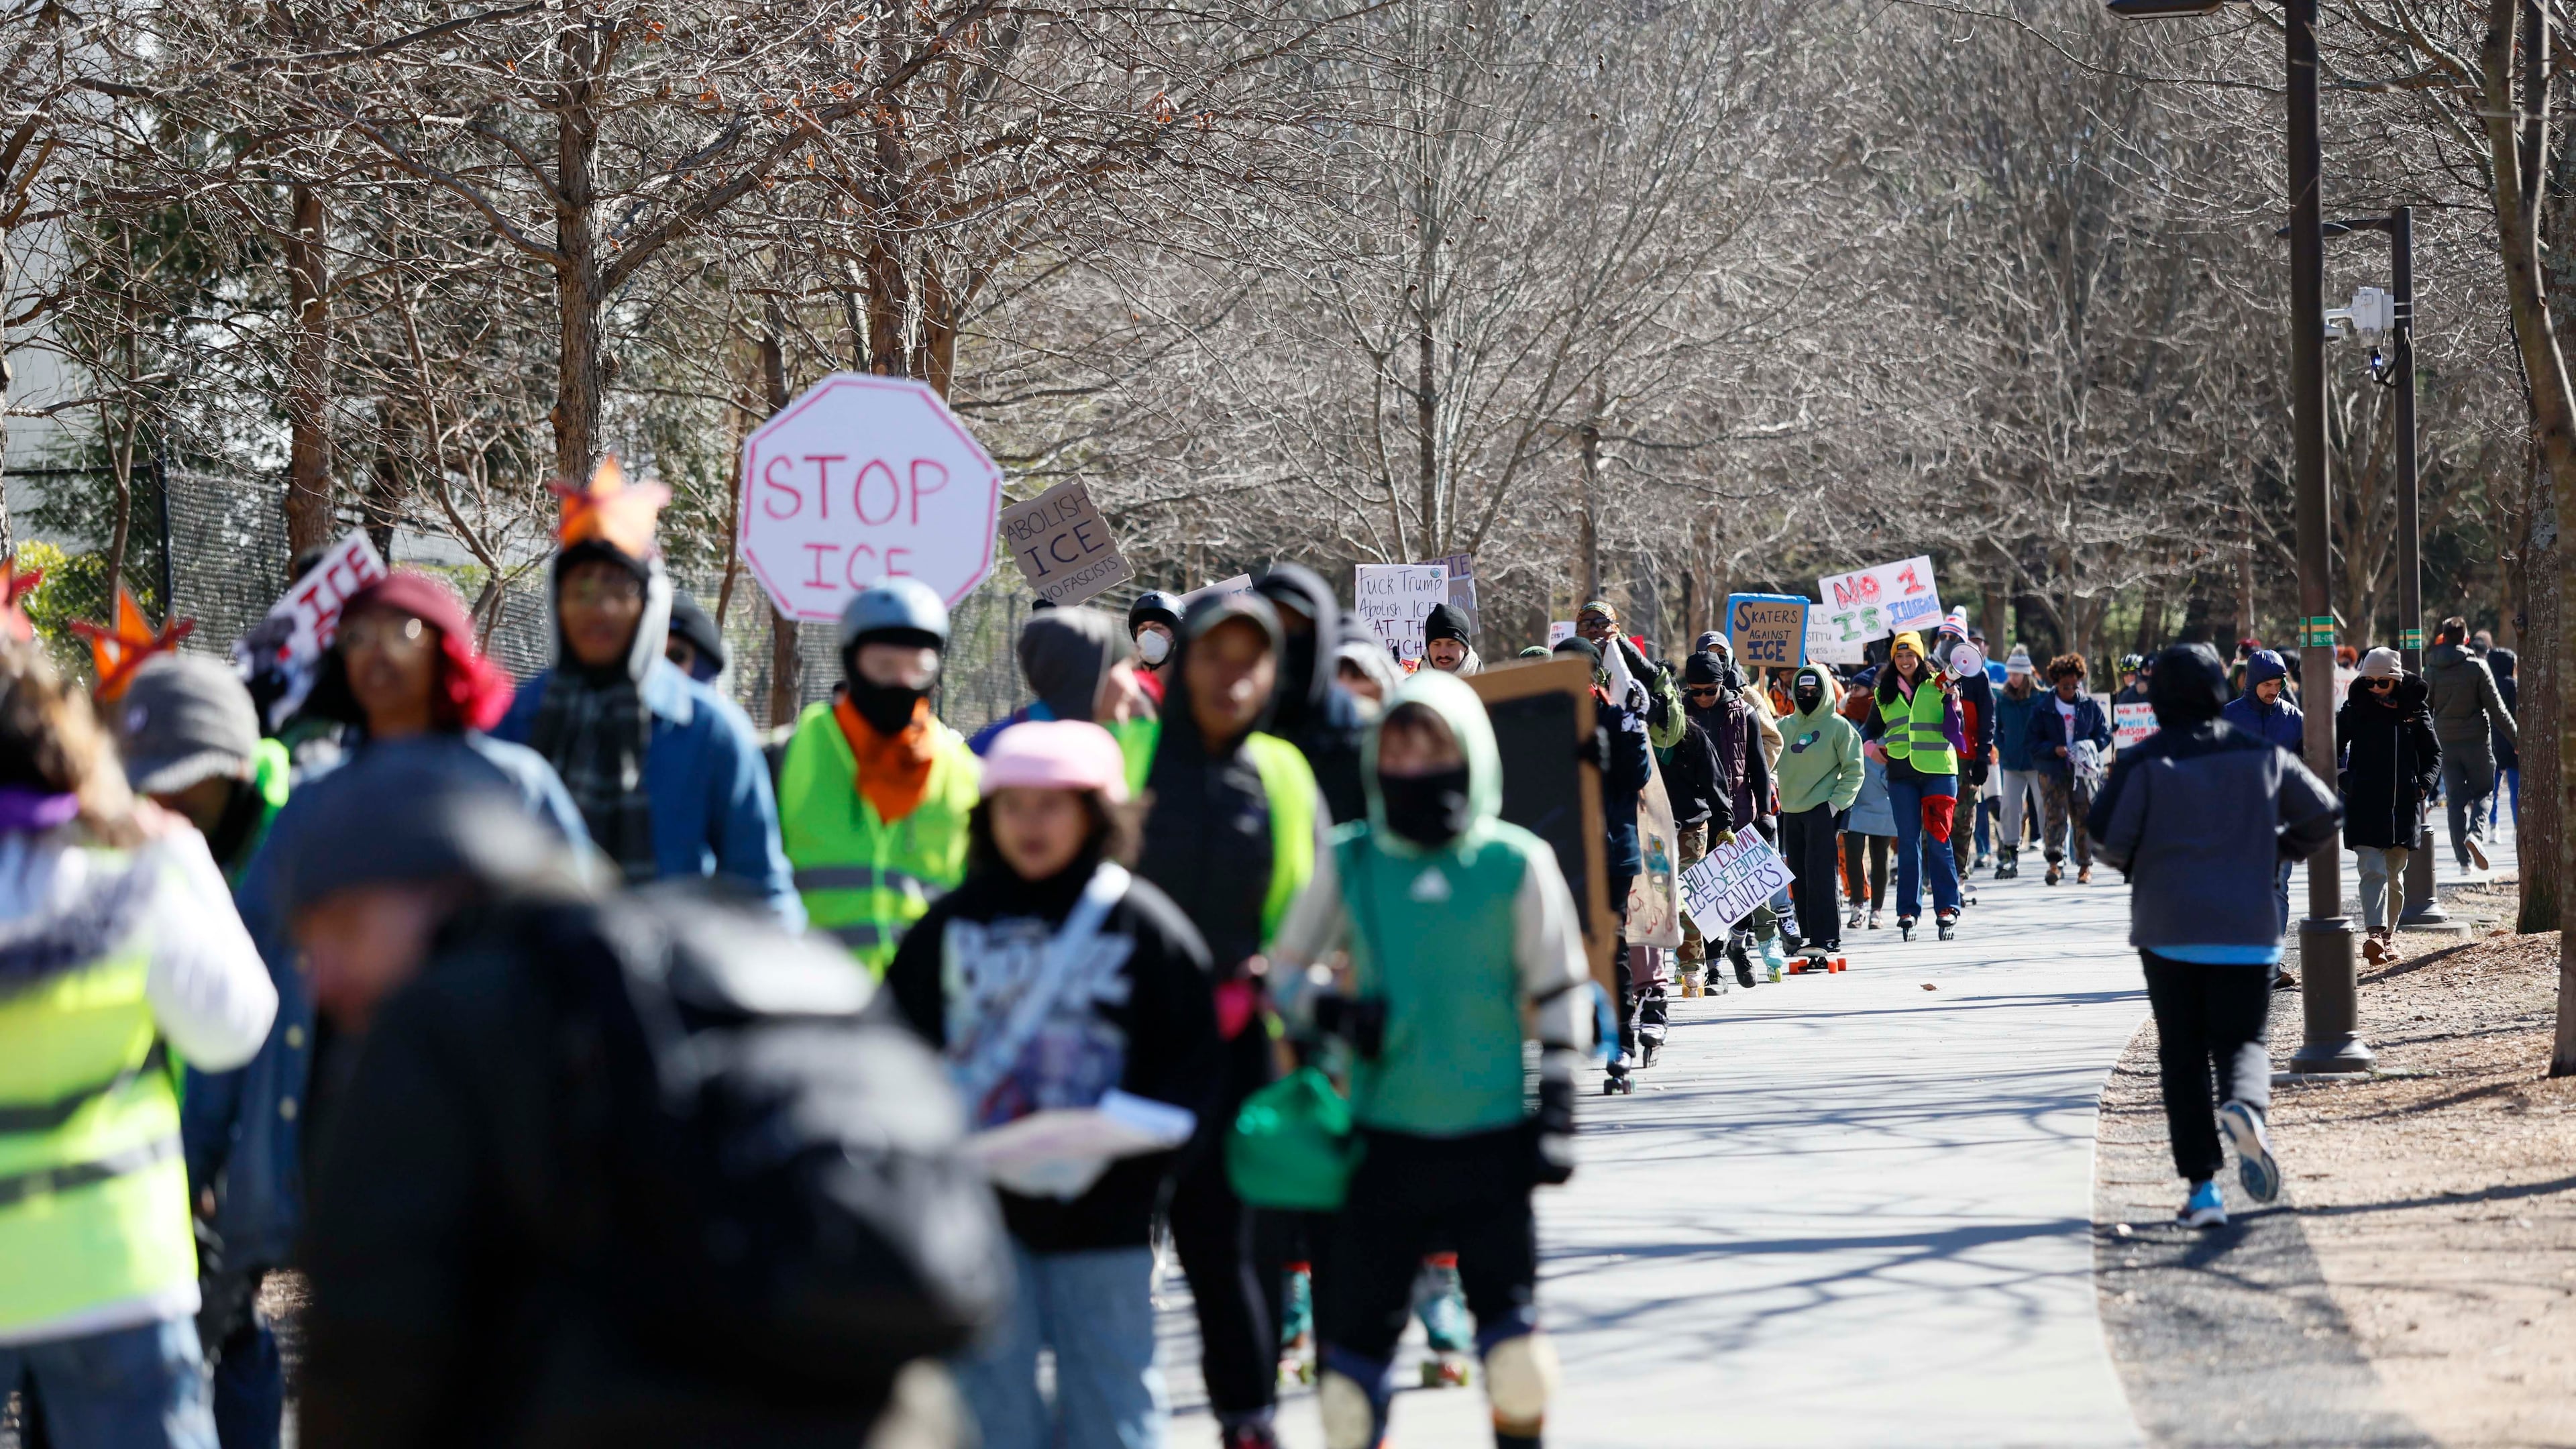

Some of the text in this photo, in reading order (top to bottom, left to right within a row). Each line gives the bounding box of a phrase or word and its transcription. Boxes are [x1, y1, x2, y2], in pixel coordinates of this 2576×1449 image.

[763, 453, 949, 527] STOP
[1007, 488, 1093, 546] ABOLISH
[1024, 519, 1104, 577] ICE
[299, 545, 380, 630] ICE
[1040, 557, 1118, 601] NO FASCISTS
[1360, 567, 1395, 596] Fuck
[1397, 570, 1442, 596] Trump
[1833, 564, 1926, 610] NO 1
[1359, 598, 1401, 618] Abolish
[1735, 601, 1798, 632] SKATERS
[1831, 606, 1879, 643] IS
[1386, 638, 1422, 656] RICH
[1405, 620, 1426, 637] TH
[1750, 629, 1792, 640] AGAINST
[1747, 640, 1787, 662] ICE
[2116, 706, 2154, 715] We hav
[1678, 827, 1758, 900] SHUT DOWN
[1685, 841, 1773, 918] ICE DETENTION
[1715, 863, 1783, 924] CENTERS
